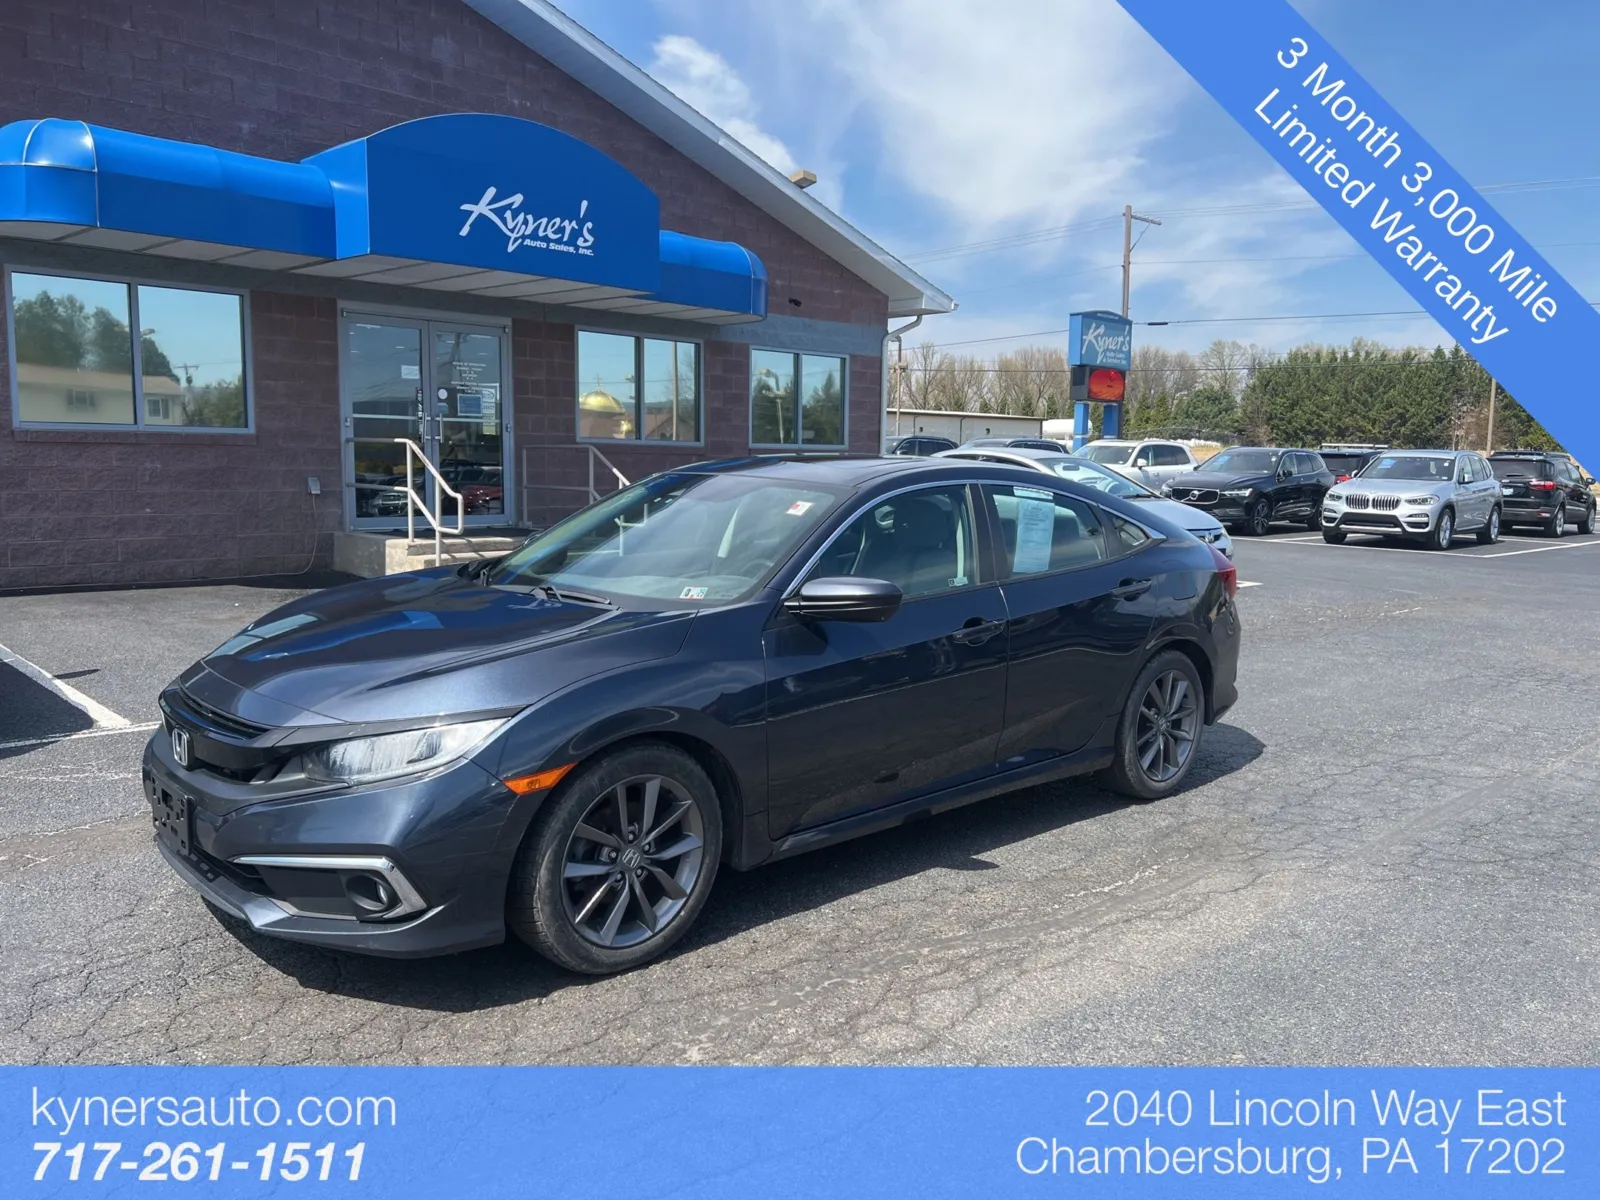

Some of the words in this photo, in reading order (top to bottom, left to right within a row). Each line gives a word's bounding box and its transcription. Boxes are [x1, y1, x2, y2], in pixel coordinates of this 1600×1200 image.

[459, 186, 594, 253] Kyner's
[523, 238, 547, 249] Auto
[549, 242, 576, 254] Sales,
[578, 247, 594, 256] Inc.
[1082, 322, 1129, 364] Kyner's
